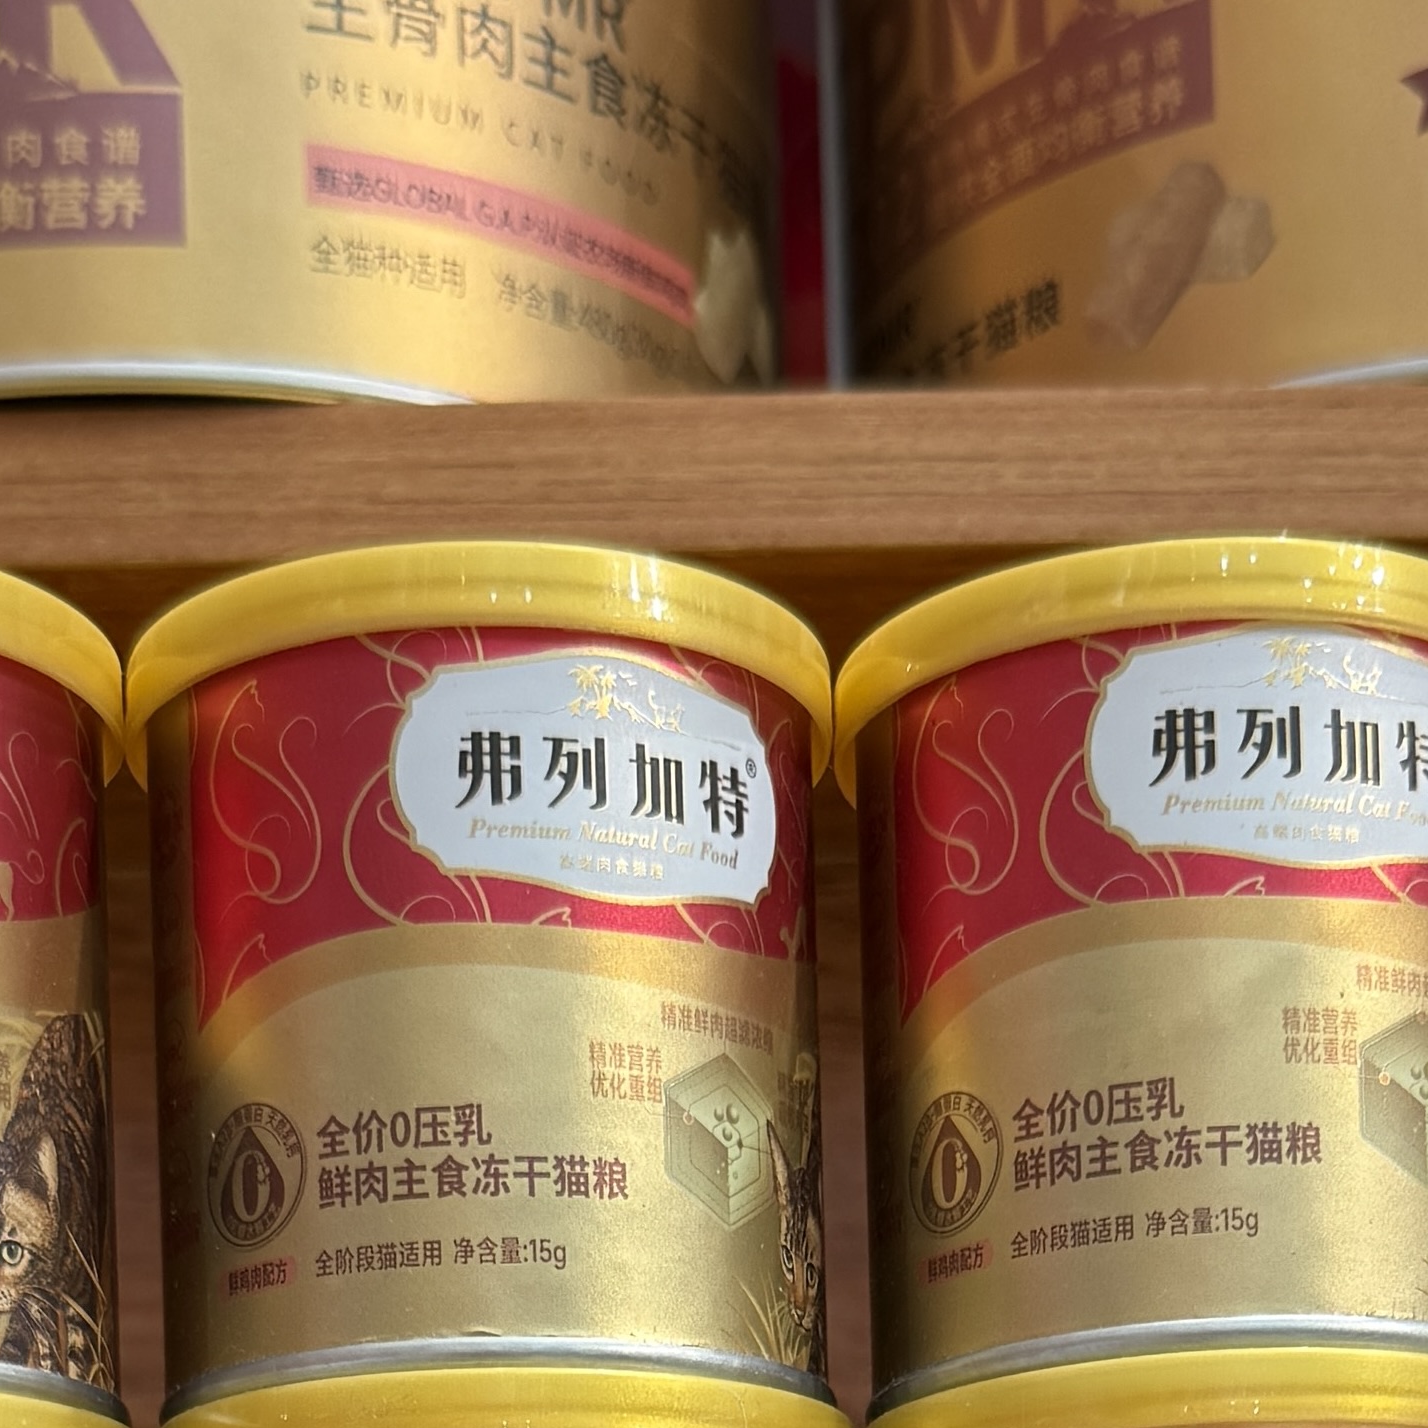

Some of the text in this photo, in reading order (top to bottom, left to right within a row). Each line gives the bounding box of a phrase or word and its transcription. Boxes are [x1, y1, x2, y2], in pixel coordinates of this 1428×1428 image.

[455, 730, 749, 839] 弗列加特
[589, 1042, 662, 1072] 精准营养
[589, 1071, 663, 1102] 优化重组
[1012, 1077, 1184, 1142] 全价0压乳
[316, 1103, 492, 1160] 全价0压乳
[1013, 1121, 1322, 1191] 鲜肉主食冻干猫粮
[316, 1154, 629, 1210] 鲜肉主食冻干猫粮
[315, 1237, 567, 1278] 全阶段猫适用 净含量:15g
[1009, 1207, 1259, 1260] 全阶段猫适用 净含量:15g
